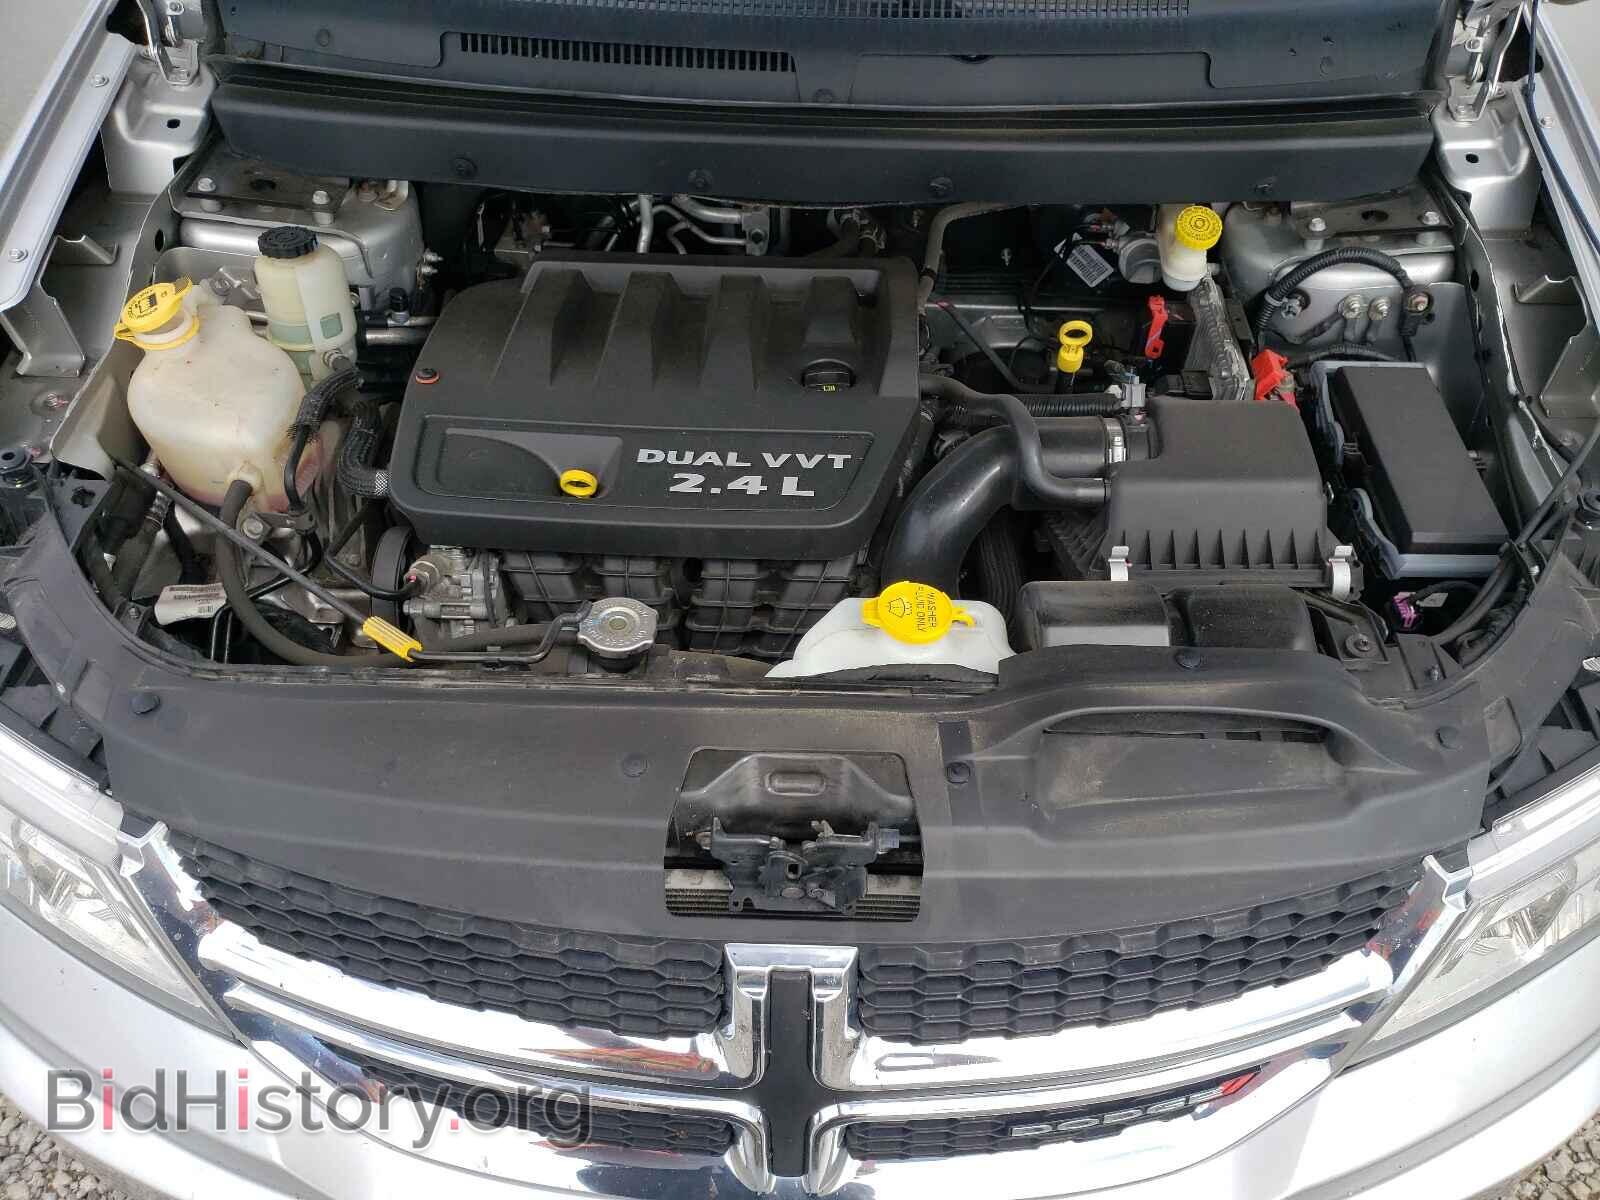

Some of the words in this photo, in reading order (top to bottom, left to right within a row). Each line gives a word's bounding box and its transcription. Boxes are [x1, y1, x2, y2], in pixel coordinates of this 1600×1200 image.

[637, 448, 752, 467] DUAL
[761, 452, 852, 469] VVT
[916, 611, 927, 632] ONLY
[927, 591, 937, 628] WASHER
[1010, 1087, 1223, 1138] DODGE
